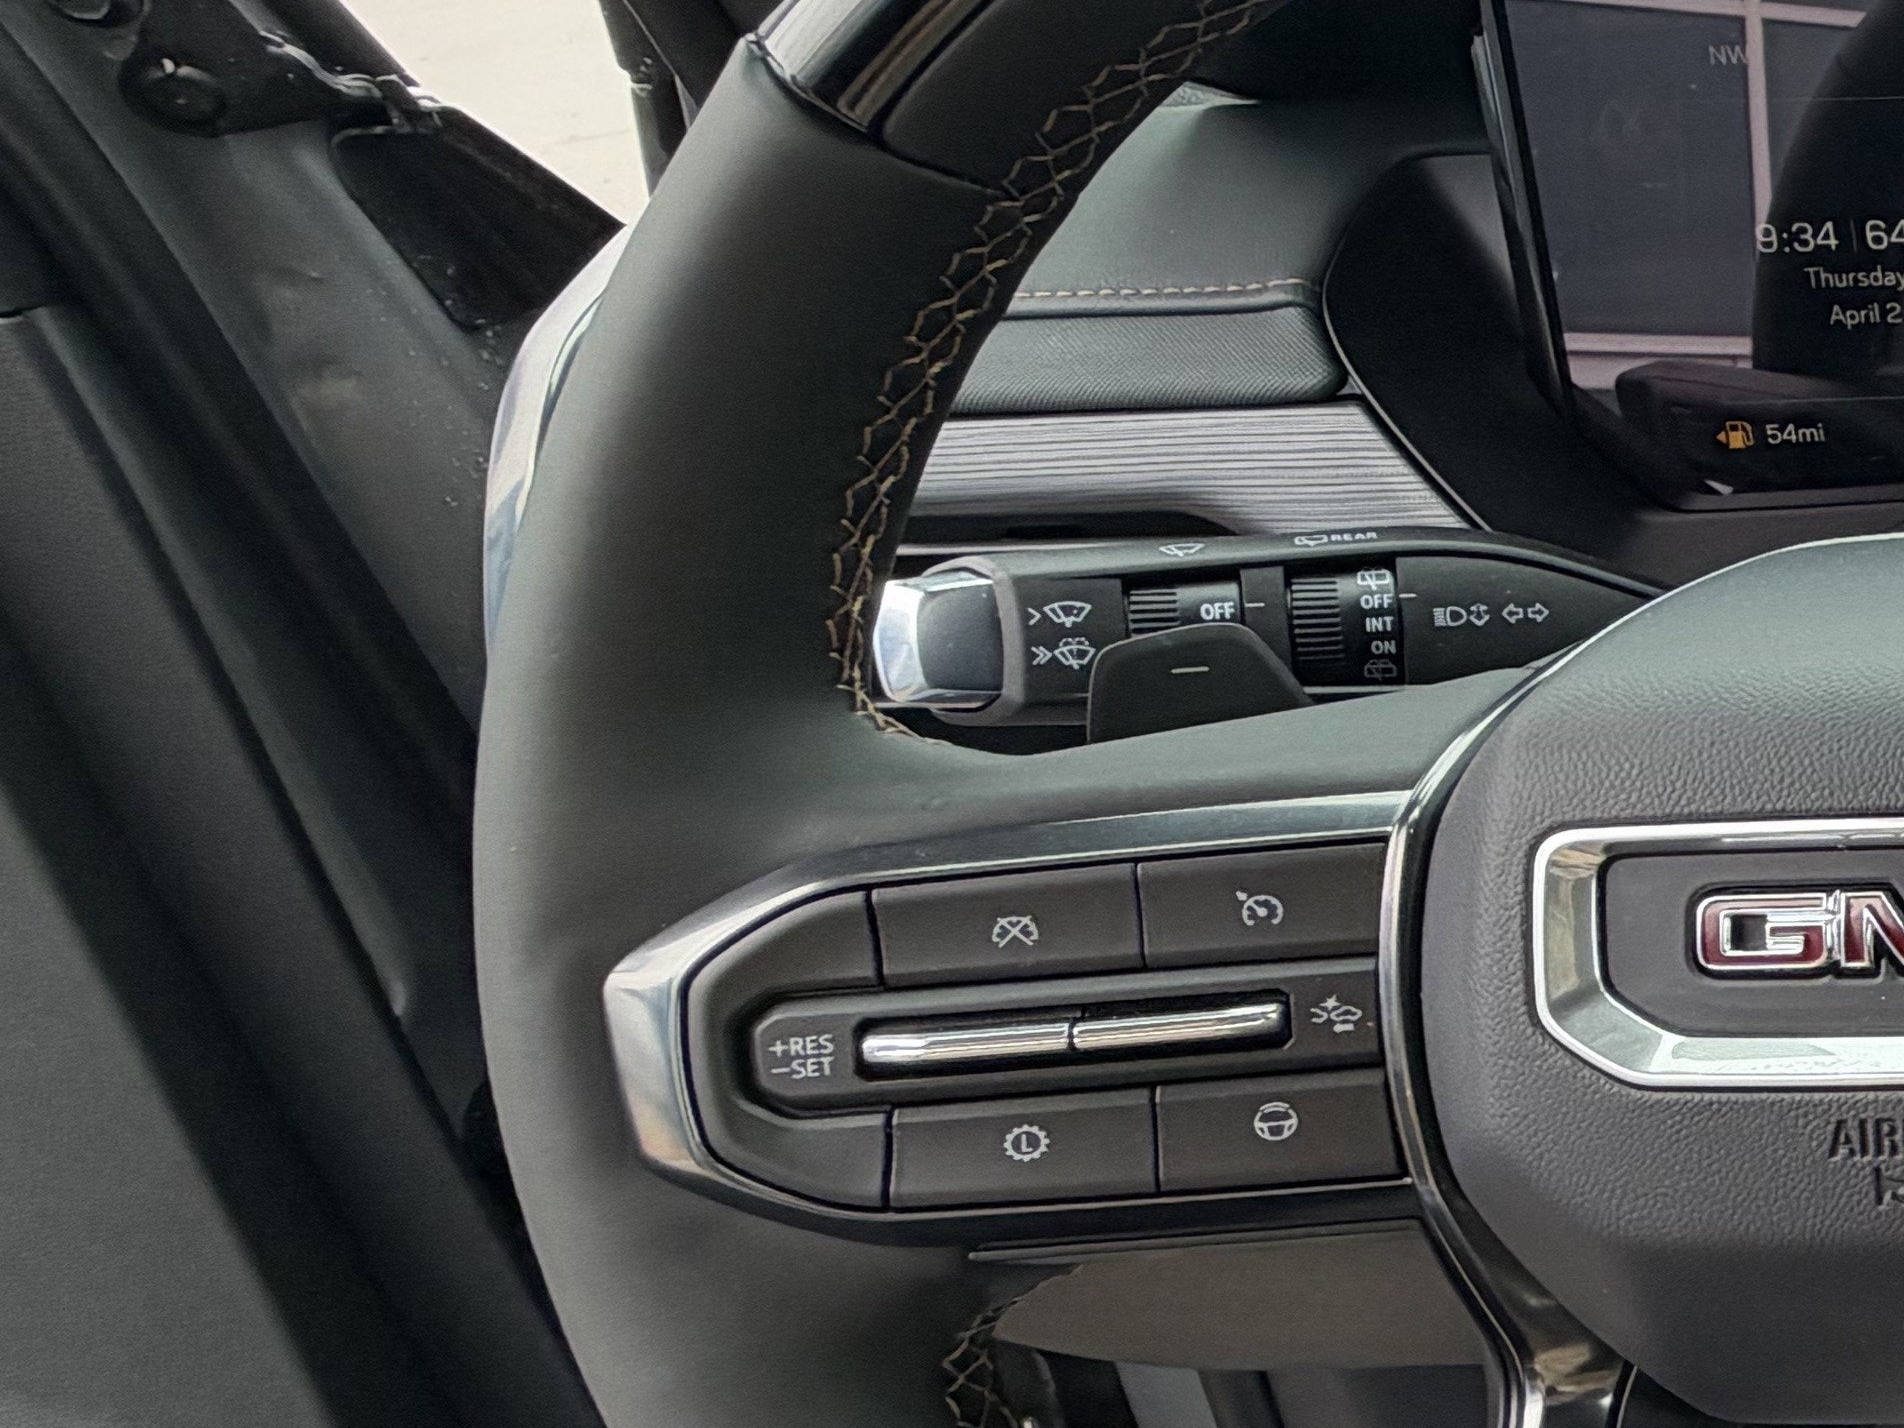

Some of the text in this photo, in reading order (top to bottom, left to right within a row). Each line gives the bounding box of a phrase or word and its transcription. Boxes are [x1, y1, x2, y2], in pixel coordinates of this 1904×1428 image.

[1756, 222, 1839, 253] 9:34
[1830, 303, 1902, 329] April 2
[1765, 422, 1825, 444] 54mi
[1330, 531, 1378, 542] REAR
[1360, 592, 1393, 609] OFF
[1200, 601, 1235, 620] OFF
[1365, 615, 1394, 633] INT
[1371, 639, 1397, 655] ON
